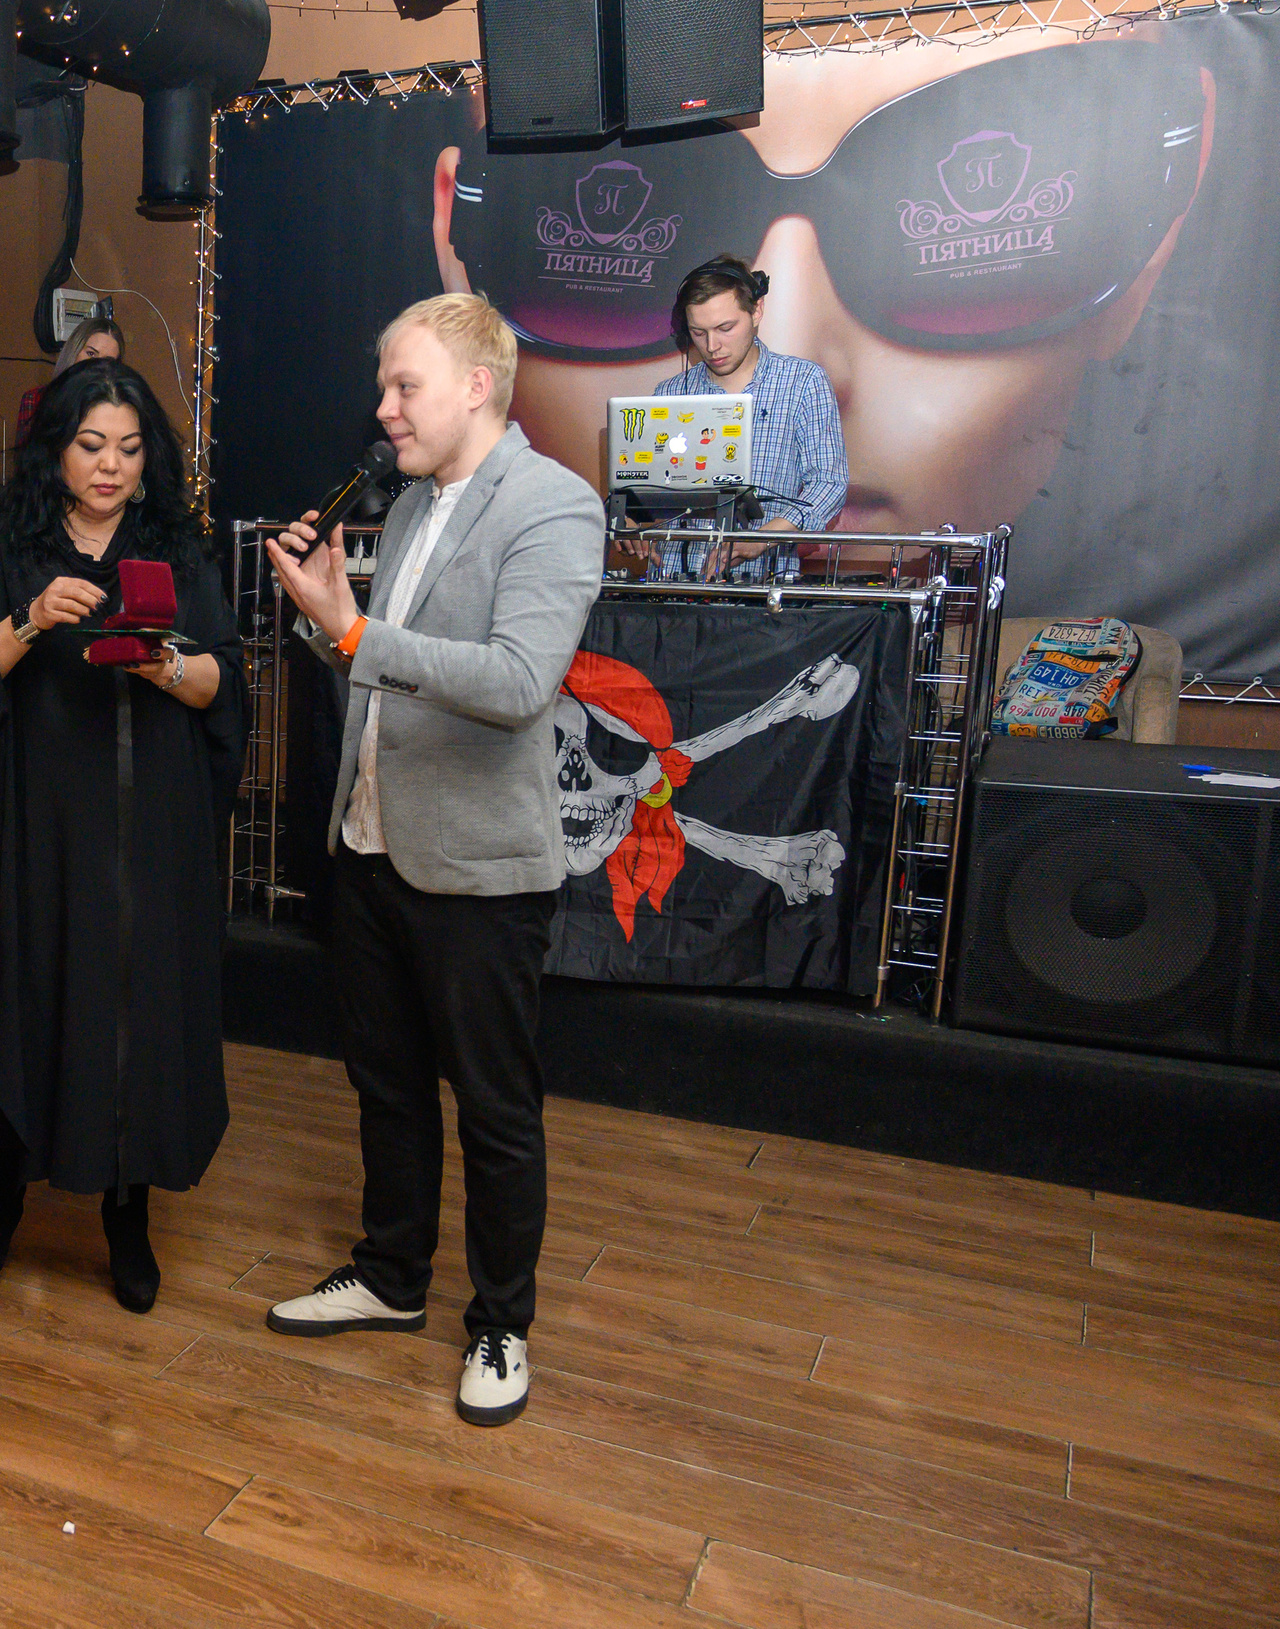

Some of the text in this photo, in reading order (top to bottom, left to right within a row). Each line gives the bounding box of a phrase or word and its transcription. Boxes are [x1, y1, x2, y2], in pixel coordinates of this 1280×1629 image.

[919, 225, 1054, 265] ПЯТНИЦА
[544, 253, 655, 284] ПЯТНИЦА
[949, 271, 965, 279] PUB
[973, 262, 1023, 276] RESTAURANT
[584, 285, 624, 293] RESTAURANT
